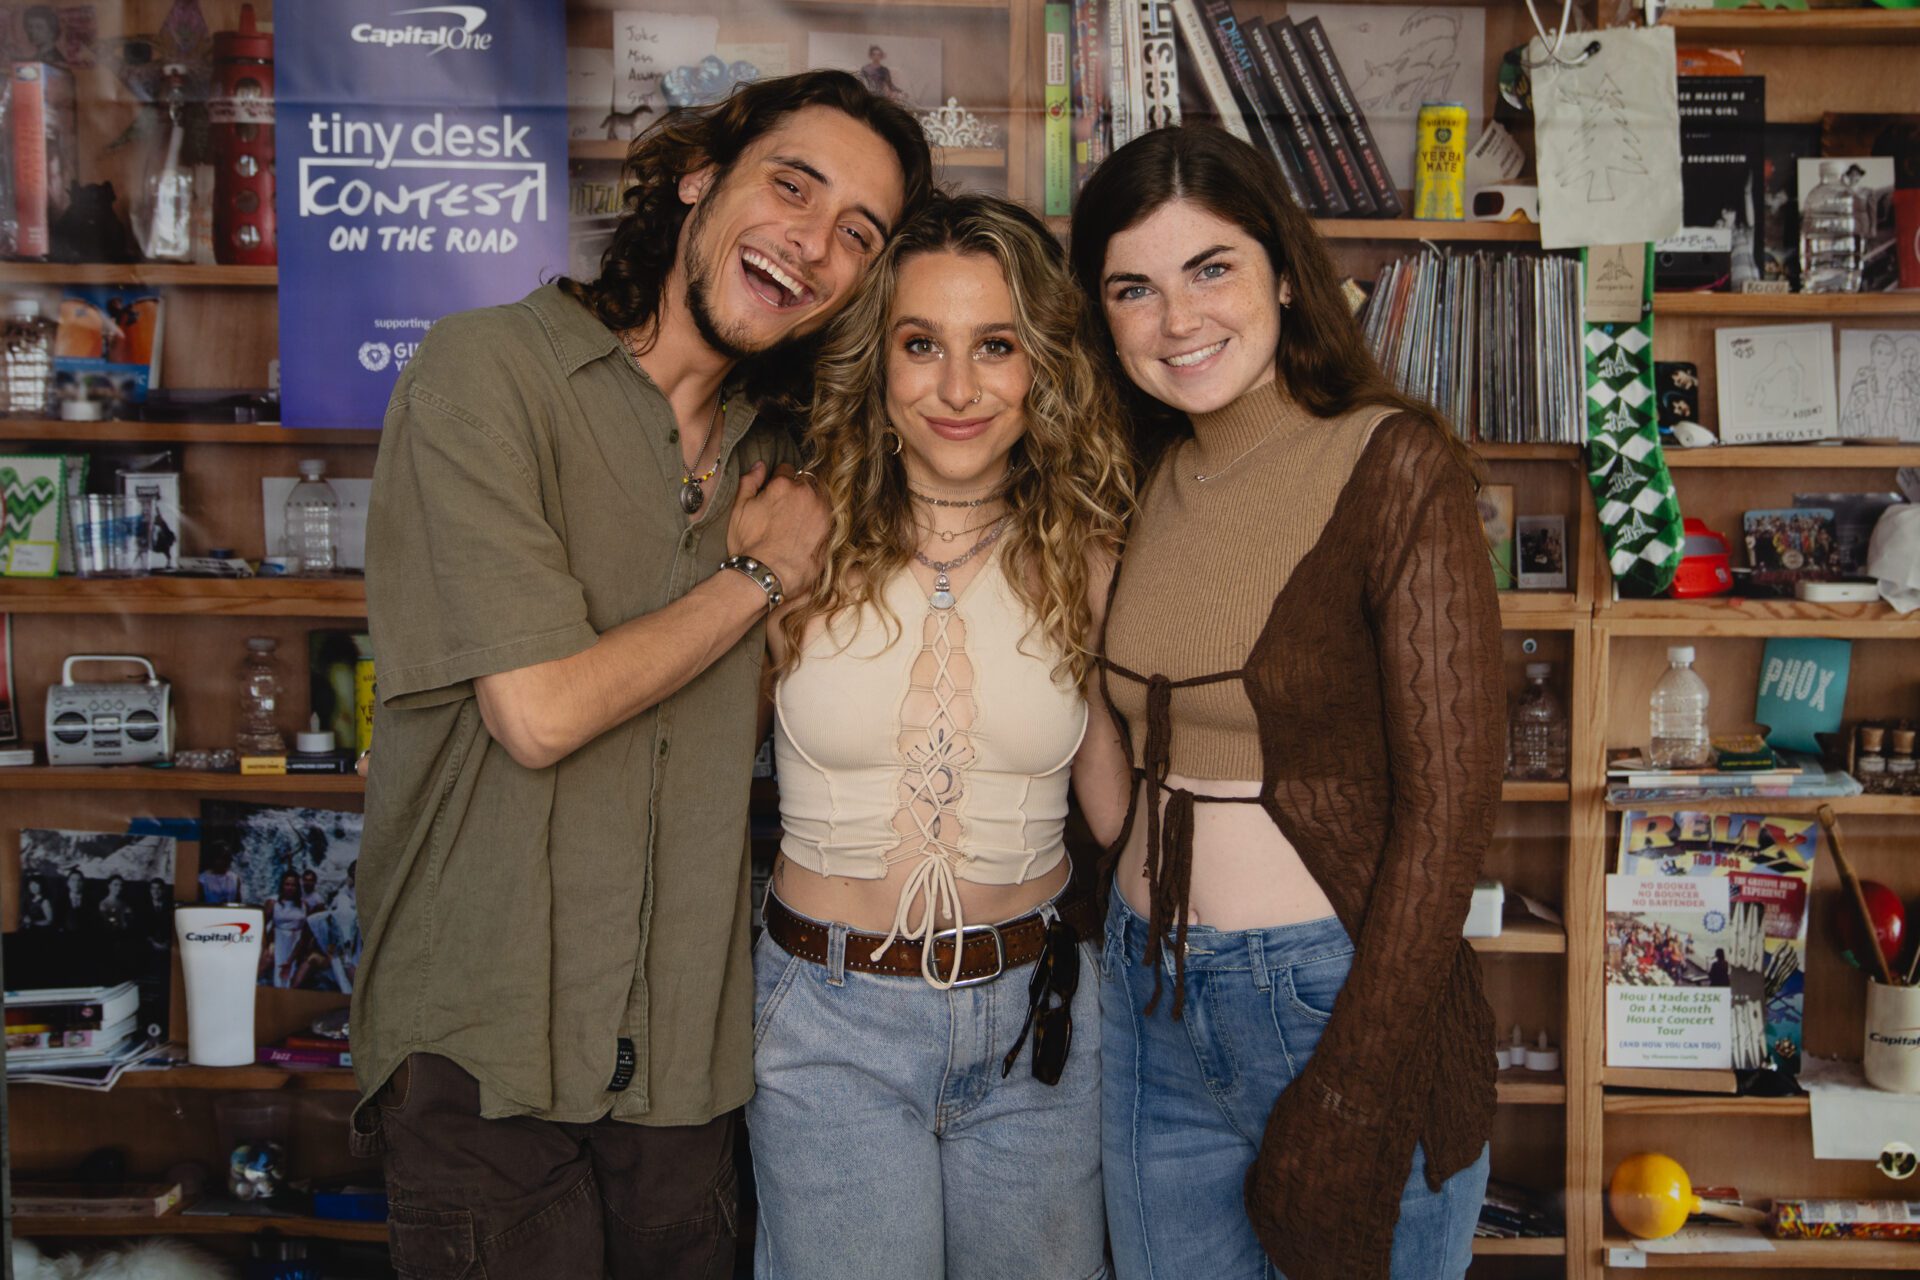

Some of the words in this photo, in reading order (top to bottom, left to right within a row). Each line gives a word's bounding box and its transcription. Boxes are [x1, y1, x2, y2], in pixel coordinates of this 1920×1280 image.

[1218, 16, 1252, 70] DREAM
[1252, 27, 1267, 51] YOUR
[1309, 27, 1324, 52] YOUR
[1262, 51, 1277, 77] SONG
[1319, 51, 1334, 77] SONG
[1280, 27, 1295, 52] YOUR
[1291, 51, 1306, 77] SONG
[1301, 75, 1325, 115] CHANGED
[1320, 114, 1332, 128] MY
[1326, 127, 1340, 147] LIFE
[1273, 75, 1297, 115] CHANGED
[1330, 75, 1354, 115] CHANGED
[1695, 92, 1727, 101] MAKES
[1731, 92, 1745, 101] ME
[1715, 107, 1738, 116] GIRL
[1292, 114, 1303, 128] MY
[1349, 114, 1360, 127] MY
[308, 112, 404, 169] tiny
[410, 113, 532, 158] desk
[1297, 127, 1311, 148] LIFE
[1354, 127, 1368, 147] LIFE
[1422, 151, 1461, 162] YERBA
[1688, 155, 1746, 163] BROWNSTEIN
[1426, 162, 1457, 173] MATE
[308, 175, 538, 223] CONTEST
[329, 226, 369, 252] ON
[377, 226, 437, 252] THE
[445, 228, 518, 253] ROAD
[374, 318, 430, 331] supporting
[1735, 429, 1824, 442] OVERCOATS
[1760, 657, 1835, 712] PHOX
[1628, 815, 1809, 870] RELIX
[1693, 853, 1711, 866] The
[1714, 854, 1741, 869] Book
[1640, 882, 1654, 890] NO
[1656, 882, 1697, 890] BOOKER
[1742, 886, 1787, 899] EXPERIENCE
[1638, 890, 1653, 898] NO
[1654, 890, 1700, 899] BOUNCER
[1632, 899, 1647, 907] NO
[1648, 899, 1705, 907] BARTENDER
[1619, 992, 1647, 1001] How
[1658, 992, 1690, 1002] Made
[1693, 992, 1721, 1002] $25K
[1629, 1004, 1645, 1013] On
[1649, 1004, 1656, 1013] A
[1660, 1004, 1712, 1014] 2-Month
[1626, 1015, 1664, 1024] House
[1667, 1015, 1715, 1025] Concert
[1657, 1026, 1685, 1035] Tour
[1619, 1041, 1640, 1050] (AND
[1642, 1041, 1661, 1049] HOW
[1665, 1041, 1681, 1049] YOU
[1683, 1041, 1699, 1050] CAN
[1701, 1041, 1721, 1050] TOO)
[270, 1051, 291, 1061] Jazz
